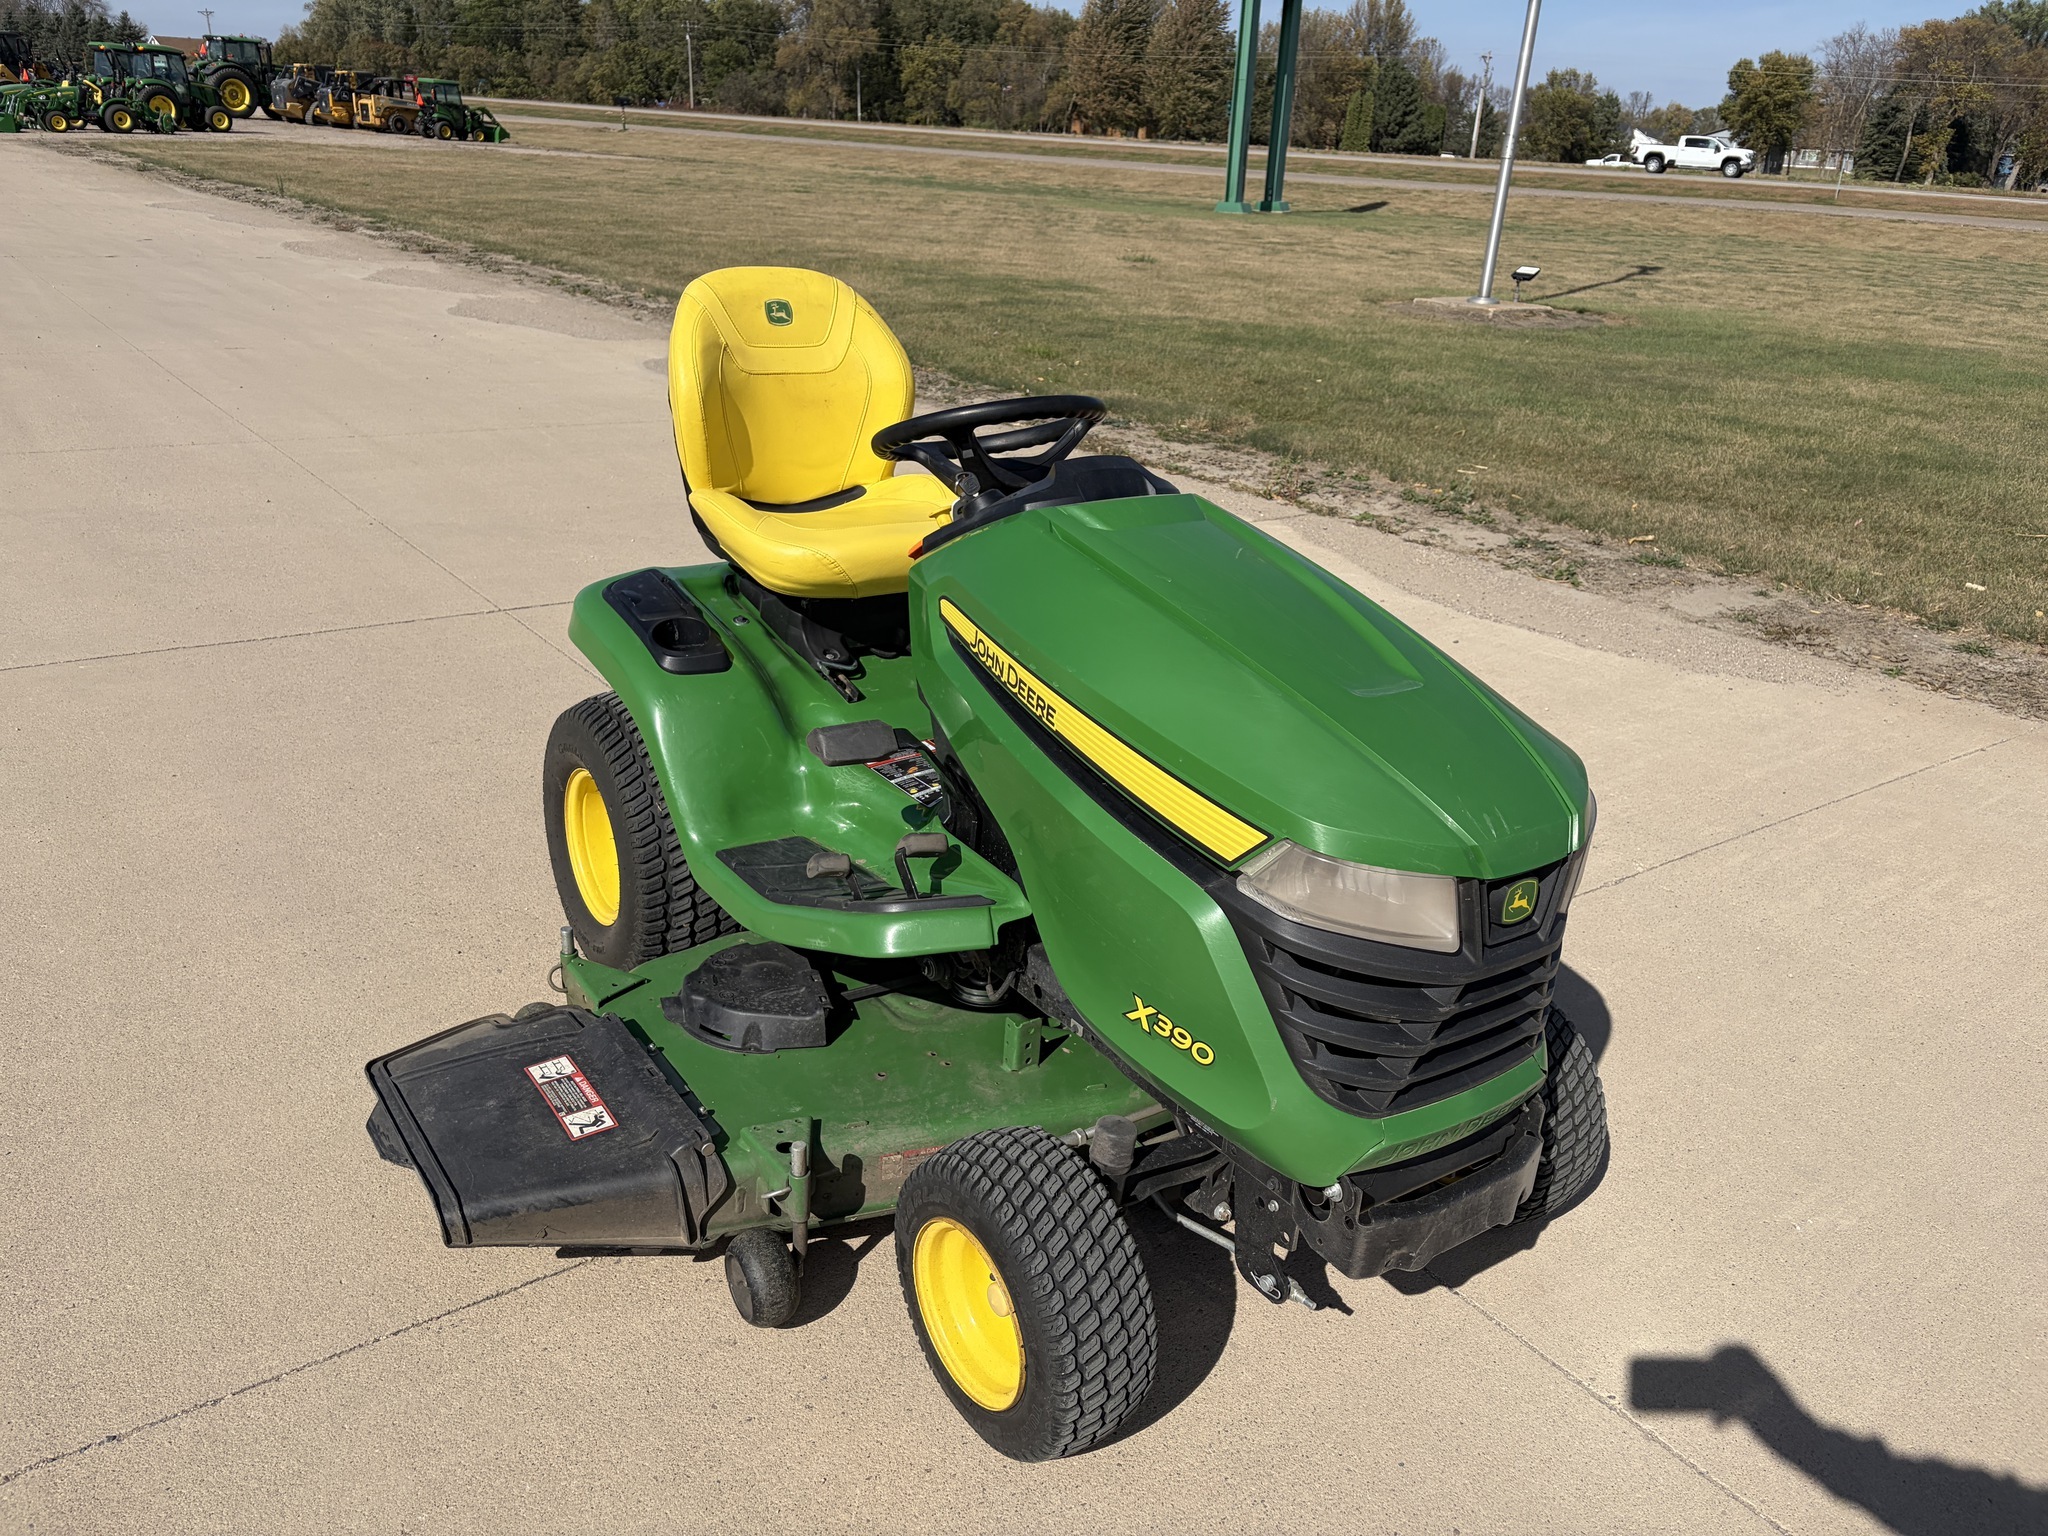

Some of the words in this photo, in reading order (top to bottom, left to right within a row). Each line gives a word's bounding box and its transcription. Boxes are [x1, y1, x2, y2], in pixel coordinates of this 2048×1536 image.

[969, 629, 1005, 679] JOHN
[1006, 662, 1058, 729] DEERE
[1122, 991, 1216, 1066] X390
[579, 1081, 599, 1103] DANGER
[1377, 1123, 1466, 1164] JOHN
